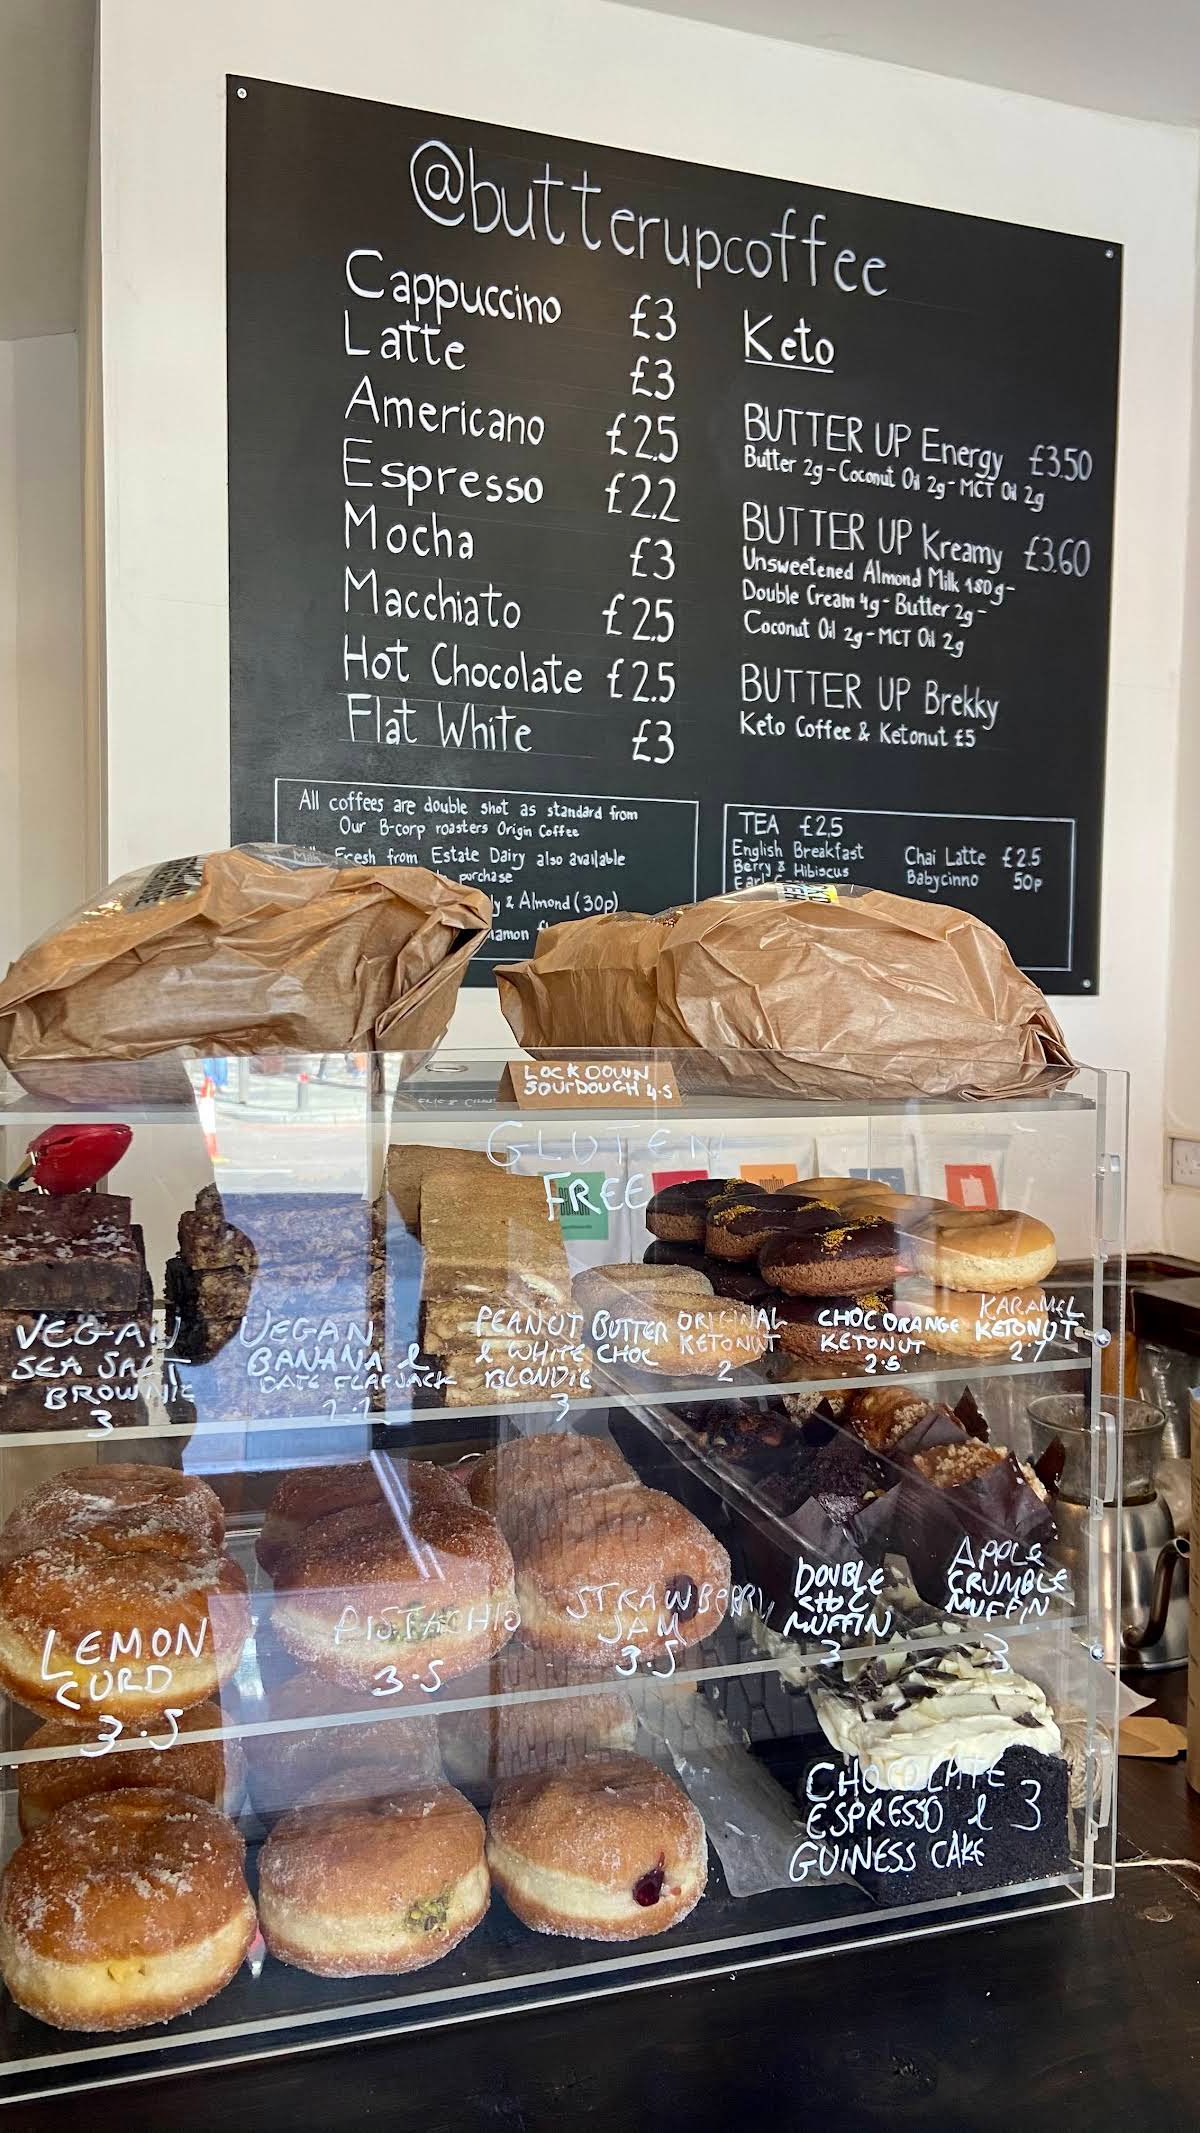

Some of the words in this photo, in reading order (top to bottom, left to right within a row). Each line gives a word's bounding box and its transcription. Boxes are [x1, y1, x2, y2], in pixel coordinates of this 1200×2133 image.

[410, 140, 888, 296] @butterupcoffee
[345, 249, 562, 324] Cappuccino
[630, 295, 678, 341] £3
[344, 310, 466, 370] Latte
[630, 356, 676, 400] £3
[743, 309, 836, 369] Keto
[344, 375, 545, 446] Americano
[605, 413, 680, 463] £2.5
[743, 402, 864, 454] BUTTER
[874, 422, 911, 458] UP
[921, 428, 1004, 480] Energy
[1028, 444, 1093, 482] £3.50
[343, 438, 544, 507] Espresso
[605, 473, 681, 523] £2.2
[744, 444, 797, 473] Butter
[902, 467, 920, 491] Oil
[1001, 481, 1017, 501] Oil
[1023, 486, 1045, 513] 2g
[344, 500, 475, 559] Mocha
[630, 537, 676, 580] £3
[742, 501, 865, 552] BUTTER
[878, 518, 912, 555] UP
[921, 522, 1003, 574] Kreamy
[1023, 535, 1091, 577] £3.60
[742, 545, 854, 580] Unsweetened
[863, 558, 921, 588] Almond
[928, 566, 960, 593] Milk
[344, 566, 522, 629] Macchiato
[602, 593, 676, 643] £2.5
[742, 578, 799, 605] Double
[806, 584, 855, 609] Cream
[895, 592, 950, 617] Butter
[743, 609, 809, 639] Coconut
[818, 617, 836, 641] Oil
[918, 627, 936, 648] Oil
[942, 633, 965, 659] 2g
[344, 634, 410, 682] Hot
[431, 642, 583, 694] Chocolate
[606, 658, 676, 703] £2.5
[740, 663, 862, 711] BUTTER
[878, 676, 912, 712] UP
[924, 679, 999, 730] Brekky
[347, 693, 418, 745] Flat
[438, 702, 533, 752] White
[631, 719, 676, 764] £3
[739, 710, 786, 736] Keto
[795, 715, 852, 743] Coffee
[859, 722, 871, 742] &
[879, 722, 949, 747] Ketonut
[955, 728, 976, 748] £5
[299, 789, 320, 811] All
[329, 791, 384, 813] coffees
[393, 798, 417, 815] are
[423, 796, 468, 815] double
[481, 798, 509, 816] shot
[520, 803, 537, 817] as
[547, 801, 603, 820] standard
[609, 804, 638, 821] from
[339, 815, 367, 835] Our
[379, 818, 426, 841] B-corp
[435, 819, 489, 836] roasters
[497, 820, 533, 841] Origin
[539, 824, 580, 838] Coffee
[739, 811, 779, 836] TEA
[799, 815, 844, 838] £2.5
[387, 848, 418, 865] from
[432, 846, 480, 865] Estate
[489, 846, 527, 871] Dairy
[536, 851, 563, 867] also
[569, 849, 626, 868] available
[732, 838, 783, 862] English
[793, 840, 865, 861] Breakfast
[733, 858, 771, 877] Berry
[794, 864, 849, 879] Hibiscus
[904, 845, 937, 867] Chai
[945, 846, 986, 868] Latte
[1002, 846, 1042, 868] £2.5
[459, 868, 514, 884] purchase
[907, 869, 979, 893] Babycinno
[1012, 871, 1043, 893] 50p
[505, 895, 514, 910] &
[519, 890, 571, 911] Almond
[573, 890, 619, 914] (30p)
[486, 1120, 726, 1167] GLUTEN
[543, 1172, 649, 1221] FREE
[16, 1313, 182, 1350] VEGAN
[475, 1305, 584, 1339] PEANUT
[591, 1309, 669, 1344] BUTTER
[677, 1306, 787, 1331] ORIGINAL
[817, 1306, 878, 1331] CHOC
[883, 1311, 960, 1334] ORANGE
[975, 1317, 1080, 1342] KETONUT
[247, 1344, 383, 1377] BANANA
[508, 1340, 586, 1366] WHITE
[597, 1344, 659, 1366] CHOC
[679, 1332, 782, 1356] KETONUT
[820, 1331, 926, 1355] KETONUT
[11, 1355, 83, 1380] SEA
[717, 1360, 734, 1382] 2
[43, 1384, 196, 1410] BROWNIE
[550, 1392, 570, 1422] 3
[87, 1409, 115, 1438] 3
[947, 1535, 1046, 1575] APPLE
[794, 1555, 885, 1598] DOUBLE
[946, 1567, 1069, 1596] CRUMBLE
[798, 1589, 871, 1614] CHOC
[944, 1591, 1051, 1625] MUFFIN
[334, 1602, 522, 1645] PISTACHIO
[597, 1612, 688, 1647] JAM
[783, 1611, 893, 1638] MUFFIN
[41, 1617, 208, 1681] LEMON
[819, 1639, 842, 1667] 3
[983, 1633, 1012, 1675] 3
[56, 1664, 174, 1711] CURD
[805, 1754, 1006, 1803] CHOCOLATE
[806, 1794, 945, 1840] ESPRESSO
[1010, 1779, 1042, 1832] 3
[788, 1837, 917, 1884] GUINESS
[931, 1829, 987, 1870] CAKE
